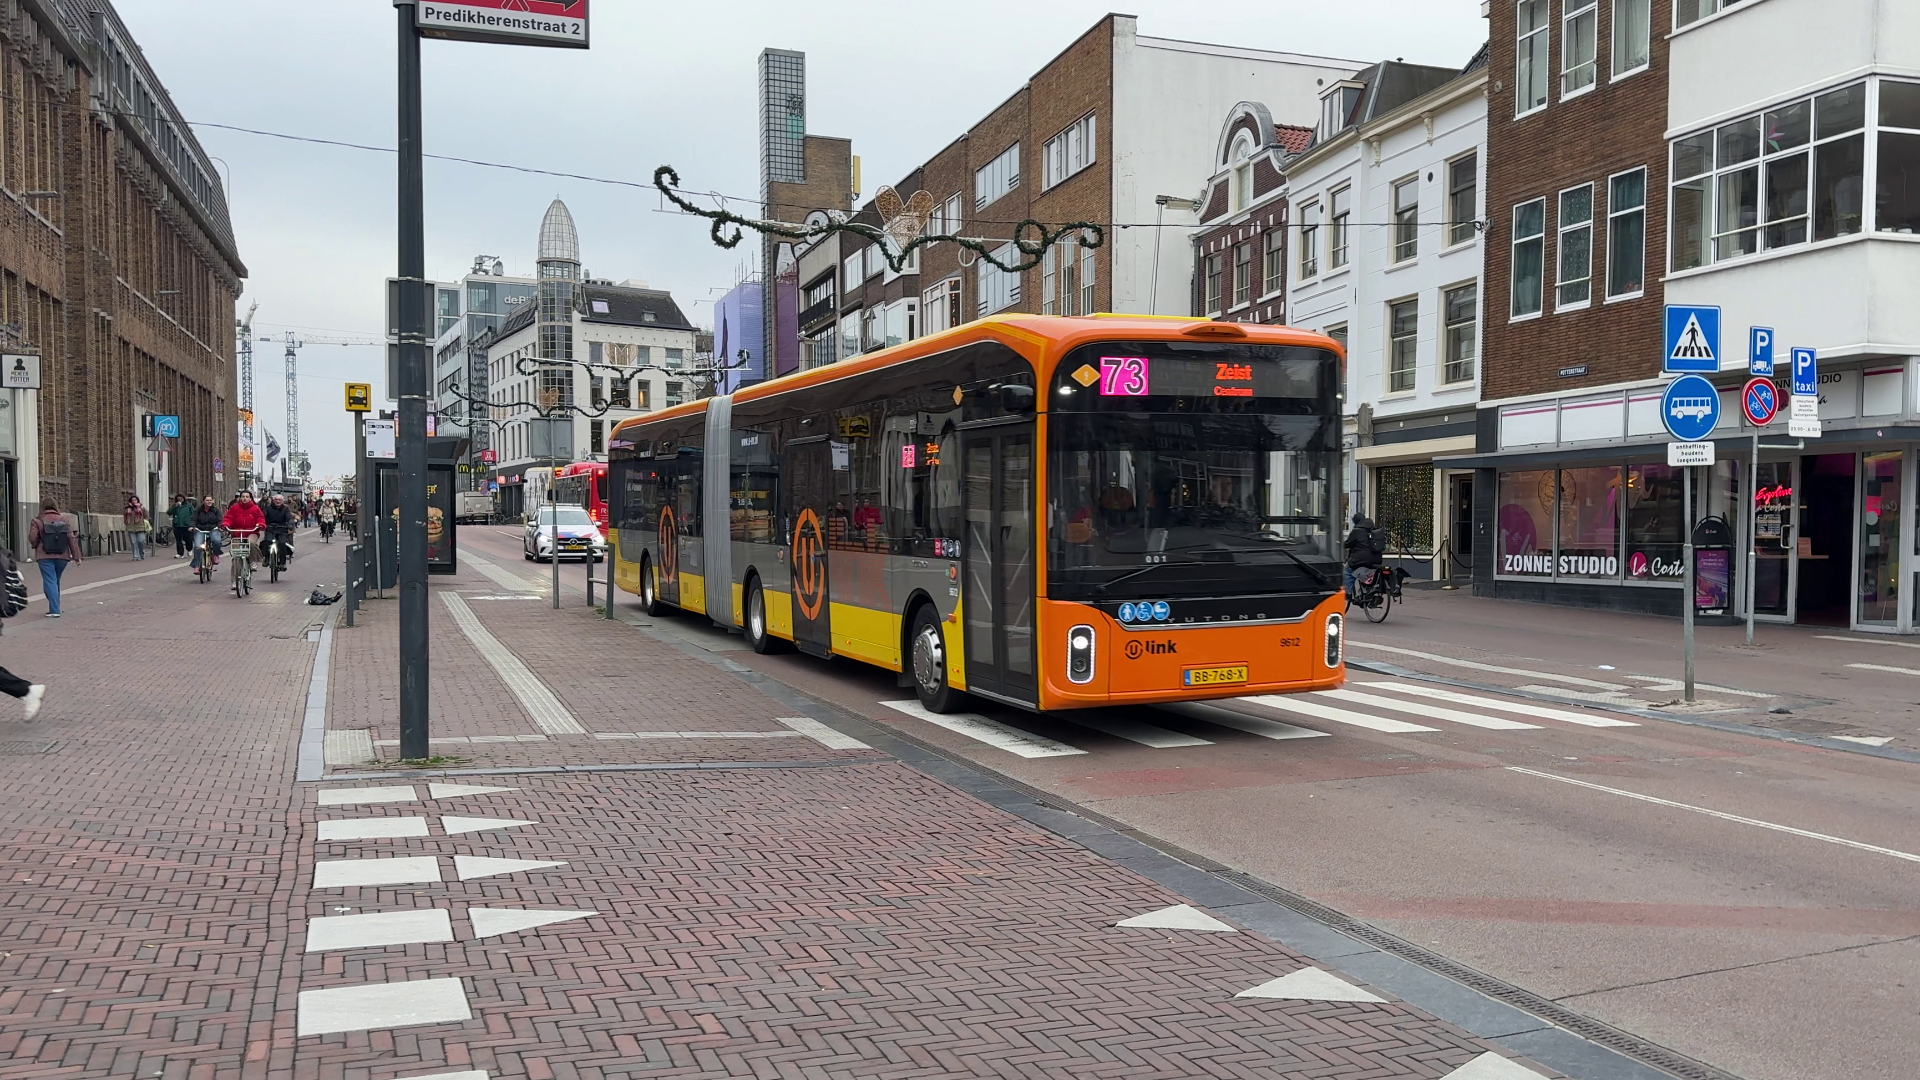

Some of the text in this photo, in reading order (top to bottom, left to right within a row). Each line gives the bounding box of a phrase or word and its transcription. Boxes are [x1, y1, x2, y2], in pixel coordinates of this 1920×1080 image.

[425, 7, 580, 35] Predikherenstraat 2
[1756, 331, 1769, 355] P
[1216, 363, 1253, 380] Zeist
[1798, 352, 1811, 375] P
[1102, 358, 1146, 395] 73
[1213, 386, 1253, 396] Centrum
[1795, 381, 1815, 392] taxi
[1145, 555, 1167, 563] 001
[1504, 554, 1552, 573] ZONNE
[1559, 555, 1617, 575] STUDIO
[1632, 557, 1648, 576] La
[1651, 557, 1684, 576] Costa
[1167, 612, 1267, 624] YUTONG
[1145, 639, 1178, 655] link
[1280, 637, 1300, 648] 9612
[1194, 669, 1245, 682] BB-768-X
